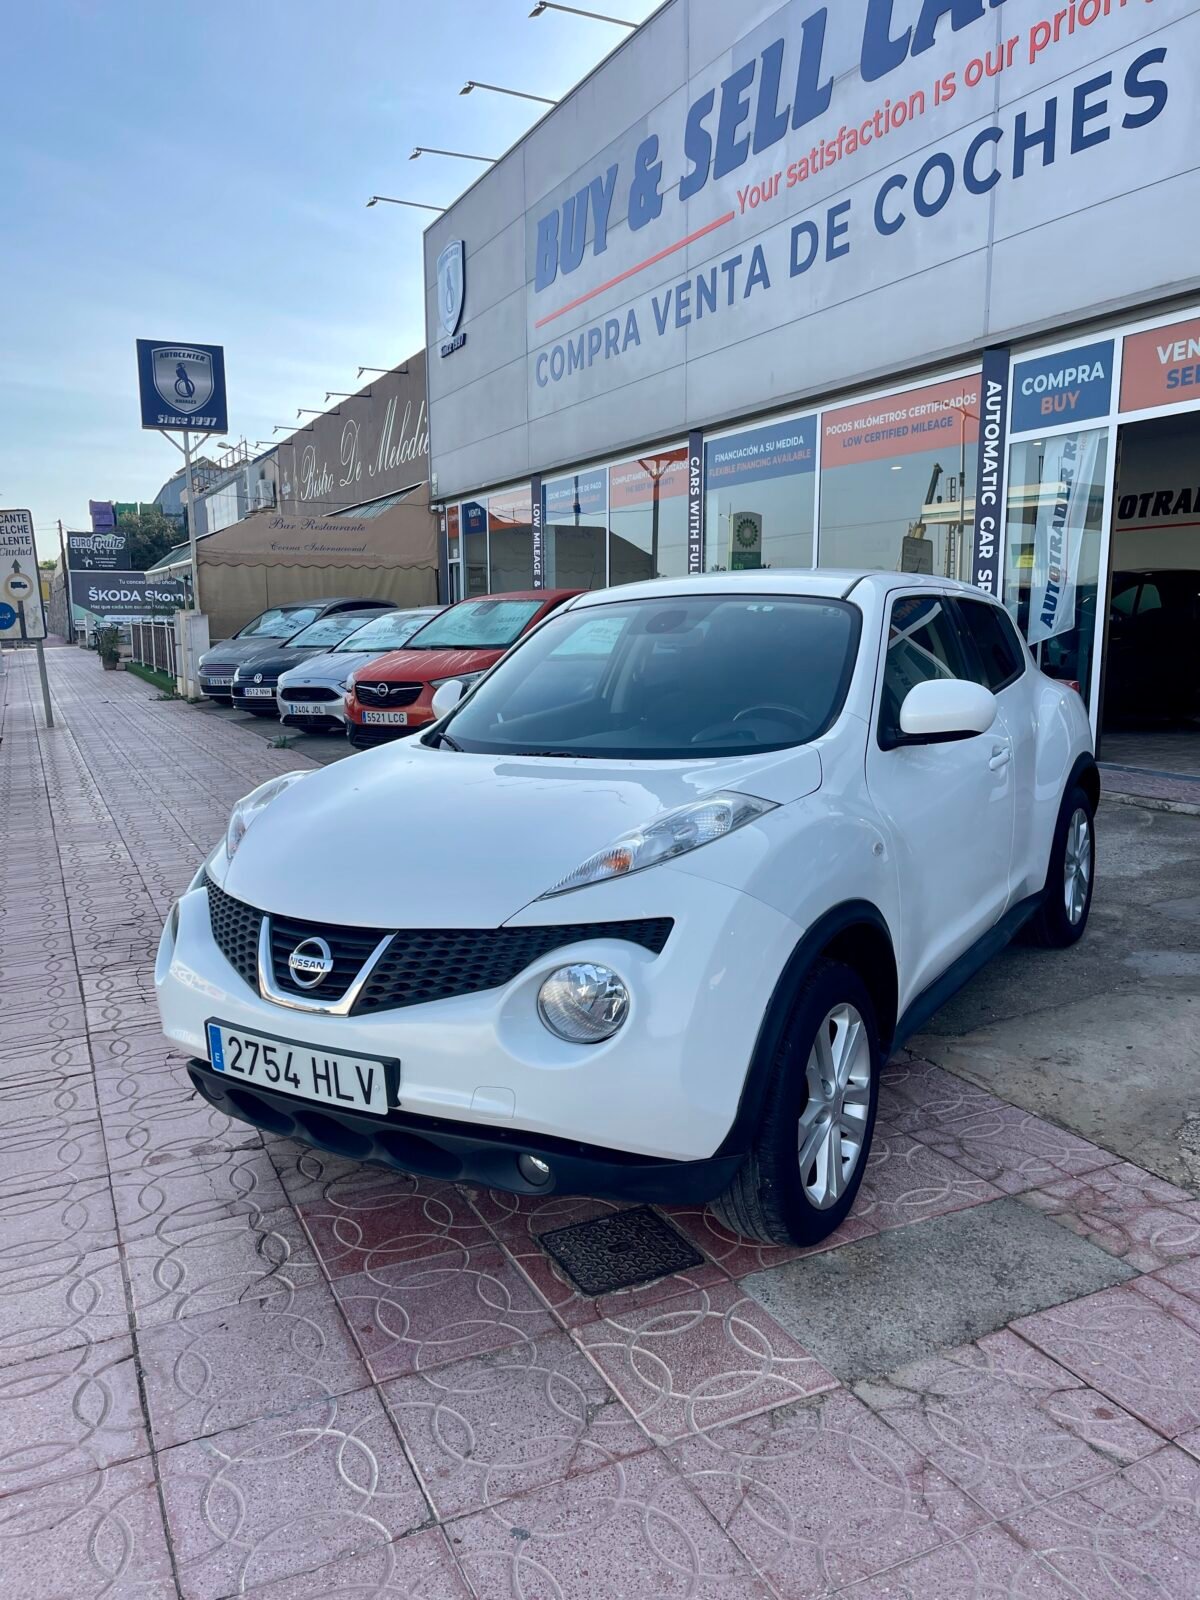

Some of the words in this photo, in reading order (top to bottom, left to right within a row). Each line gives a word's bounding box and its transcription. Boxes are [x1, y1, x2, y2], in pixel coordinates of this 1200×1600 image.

[736, 172, 781, 215] Your
[785, 90, 925, 190] satisfaction
[964, 35, 1019, 87] our
[534, 163, 618, 293] BUY
[628, 134, 664, 231] &
[679, 7, 833, 201] SELL
[535, 308, 640, 388] COMPRA
[652, 244, 771, 337] VENTA
[789, 198, 851, 278] DE
[873, 47, 1169, 236] COCHES
[160, 351, 206, 362] AUTOCENTER
[1021, 362, 1104, 396] COMPRA
[826, 421, 853, 436] POCOS
[854, 409, 907, 429] KILÓMETROS
[908, 393, 977, 418] CERTIFICADOS
[1040, 390, 1081, 415] BUY
[157, 414, 188, 425] Since
[190, 416, 217, 426] 1997
[842, 435, 862, 448] LOW
[864, 425, 908, 444] CERTIFIED
[911, 416, 953, 434] MILEAGE
[715, 444, 758, 463] FINANCIACIÓN
[759, 445, 764, 453] A
[765, 441, 774, 452] SU
[776, 435, 804, 449] MEDIDA
[982, 380, 1001, 506] AUTOMATIC
[301, 445, 334, 501] Bistro
[339, 419, 362, 487] De
[690, 457, 699, 495] CARS
[709, 463, 736, 477] FLEXIBLE
[736, 457, 771, 473] FINANCING
[772, 449, 811, 465] AVAILABLE
[268, 517, 296, 530] Bar
[300, 518, 366, 532] Restaurante
[690, 500, 699, 539] WITH
[533, 532, 541, 575] MILEAGE
[979, 517, 994, 559] CAR
[88, 587, 142, 602] ŠKODA
[294, 705, 309, 714] 2404
[367, 712, 385, 722] 5521
[387, 713, 405, 723] LCG
[290, 956, 326, 970] NISSAN
[214, 1052, 220, 1064] E
[228, 1036, 301, 1089] 2754
[311, 1057, 374, 1105] HLV
